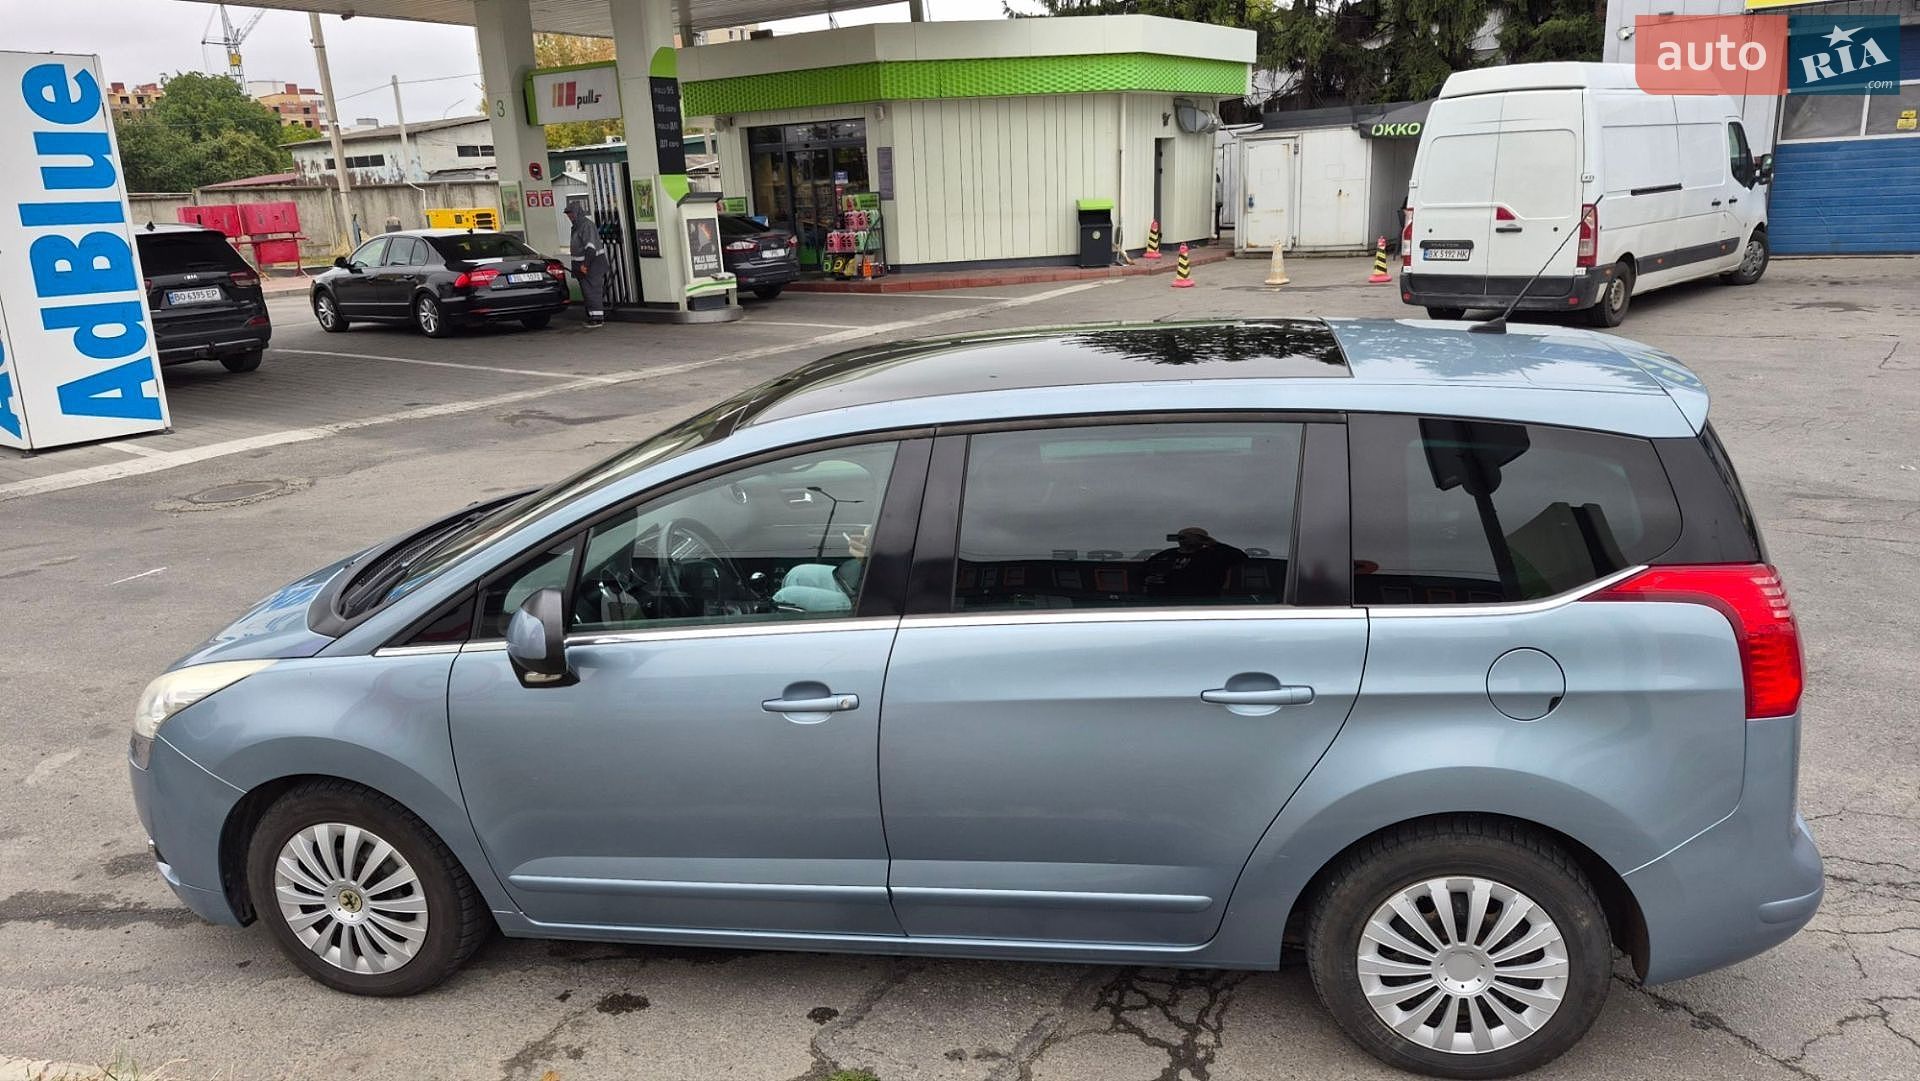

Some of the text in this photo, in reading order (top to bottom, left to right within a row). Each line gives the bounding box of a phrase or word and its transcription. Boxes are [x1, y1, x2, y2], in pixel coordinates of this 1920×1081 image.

[496, 99, 505, 117] 3
[576, 88, 602, 110] pulls
[1371, 122, 1421, 136] OKKO
[18, 63, 163, 421] AdBlue
